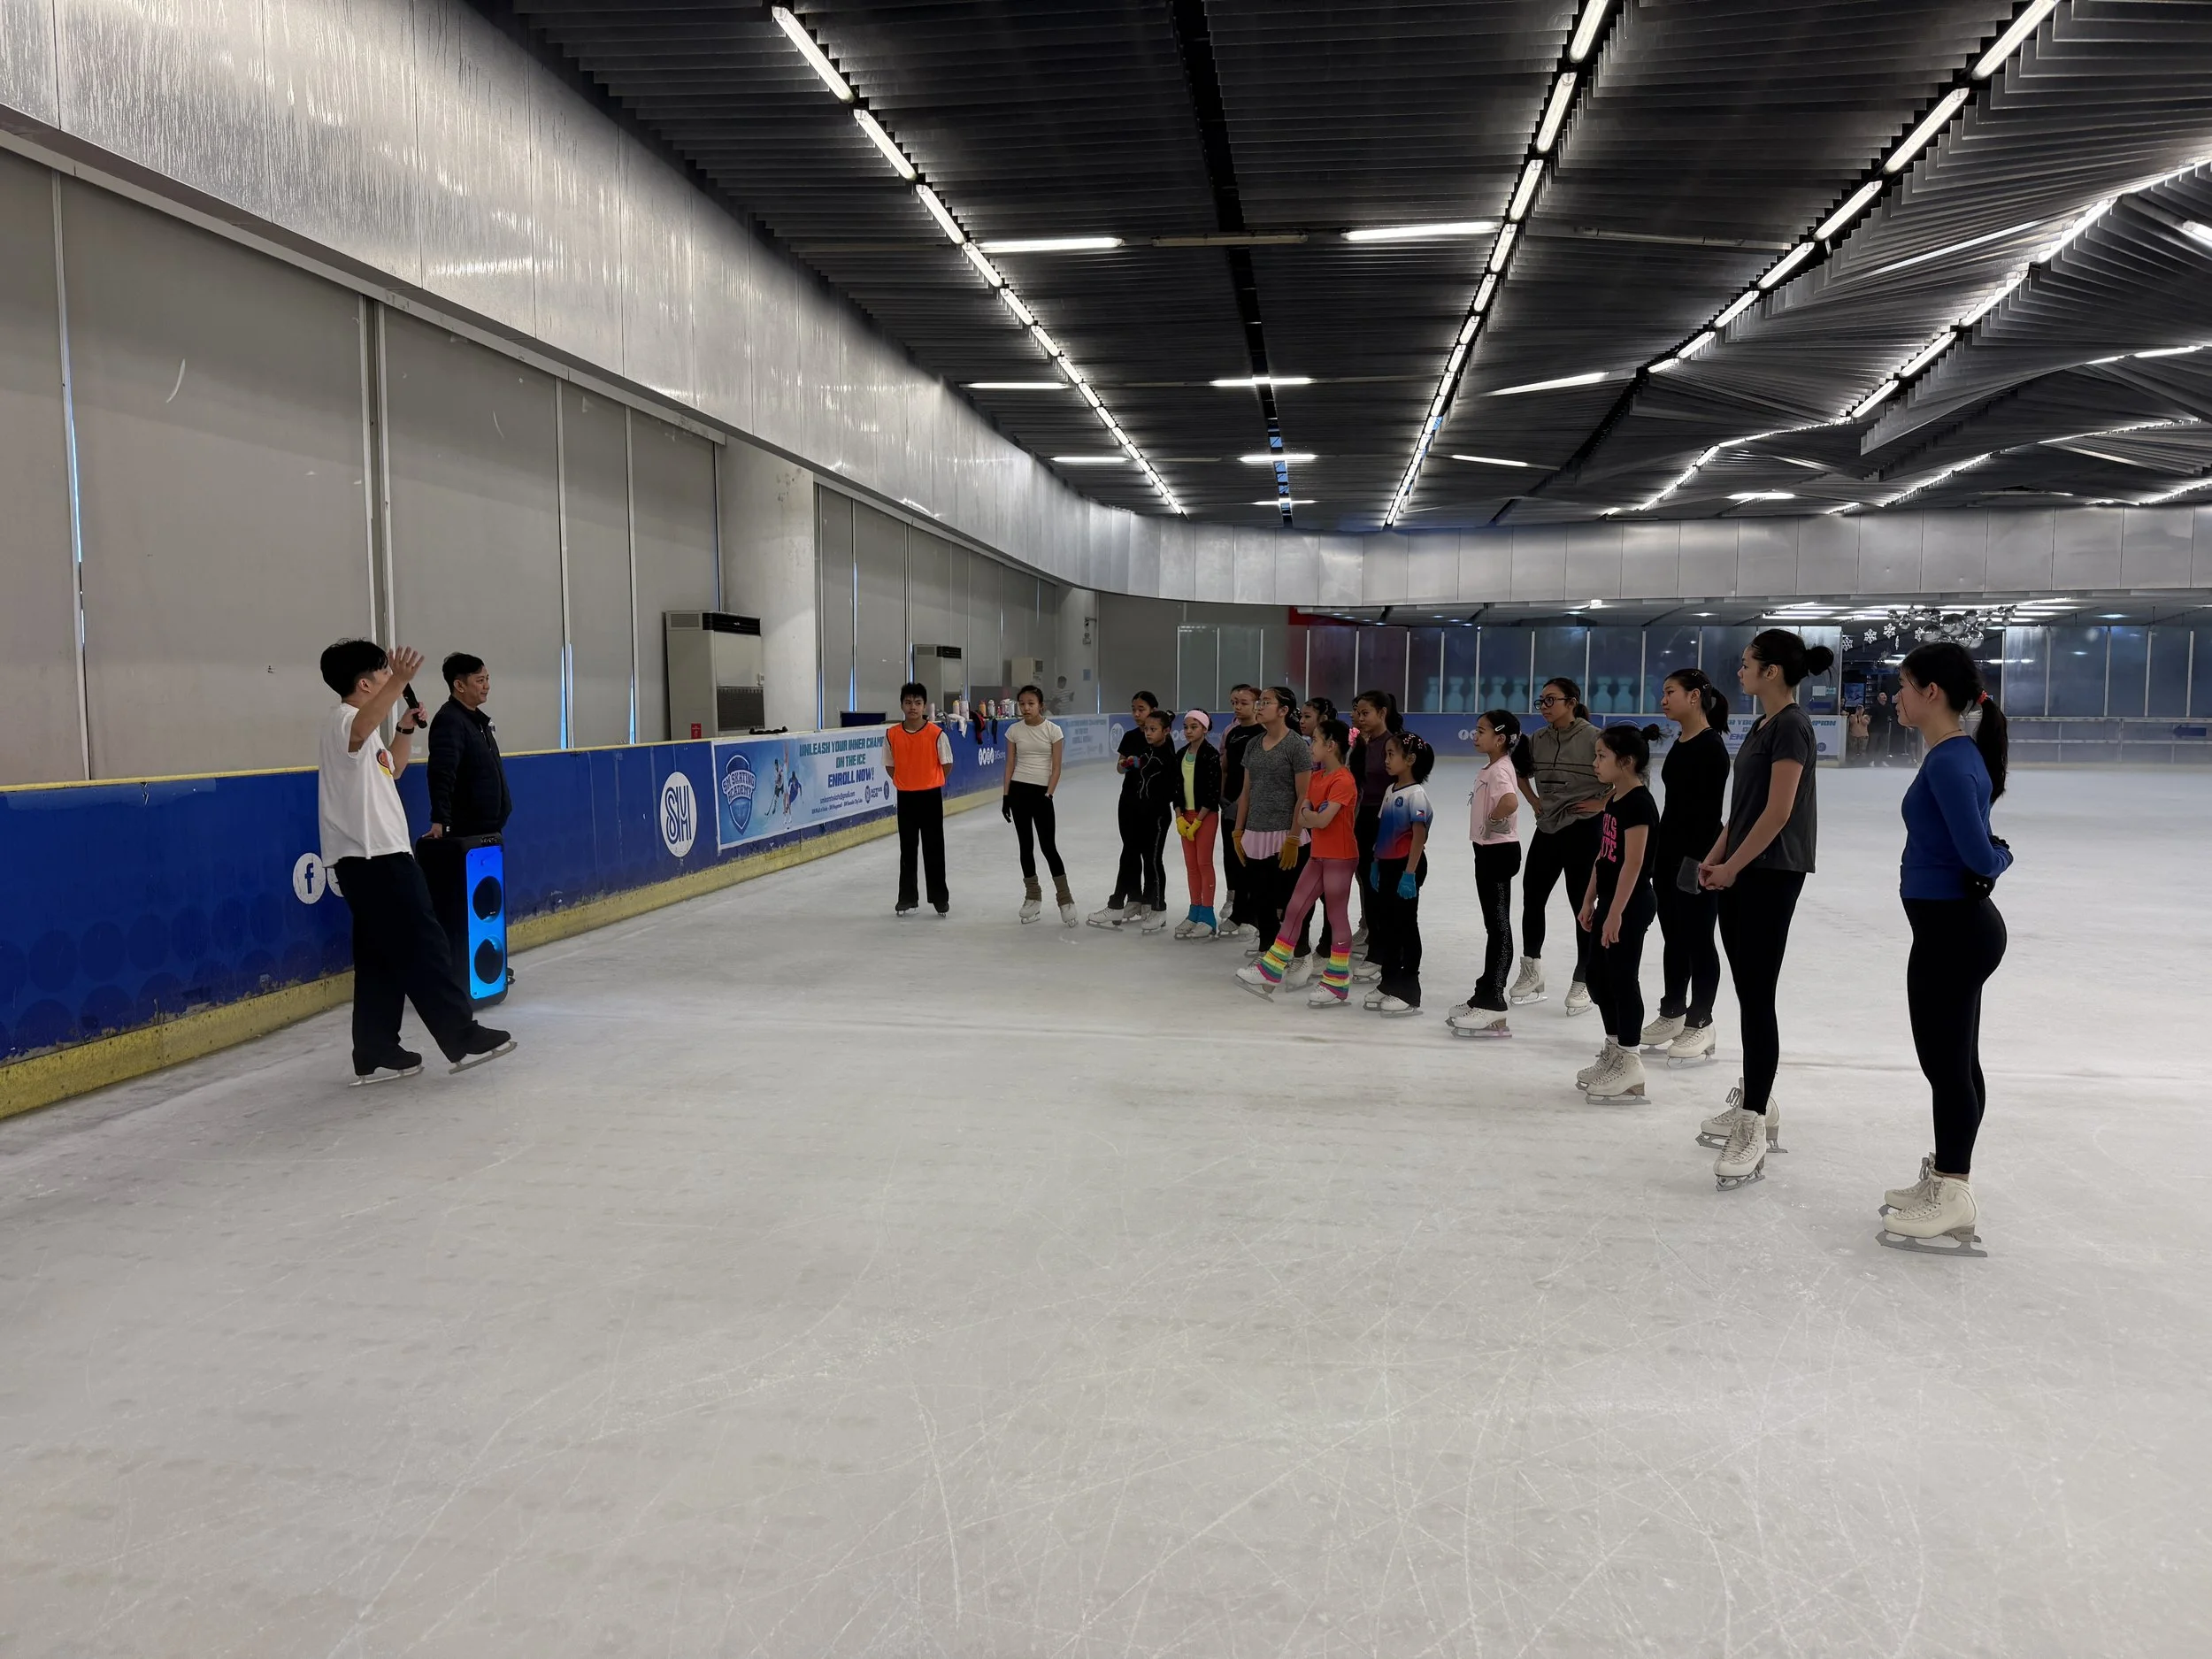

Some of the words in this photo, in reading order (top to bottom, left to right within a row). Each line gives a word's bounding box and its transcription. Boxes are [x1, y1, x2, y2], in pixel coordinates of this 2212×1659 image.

[799, 741, 830, 757] UNLEASH
[832, 740, 848, 753] YOUR
[848, 738, 865, 751] INNER
[866, 736, 885, 749] CHAMP
[835, 757, 845, 768] ON
[846, 755, 856, 767] THE
[856, 753, 866, 765] ICE
[827, 770, 855, 787] ENROLL
[856, 766, 874, 782] NOW!
[665, 785, 692, 845] SM
